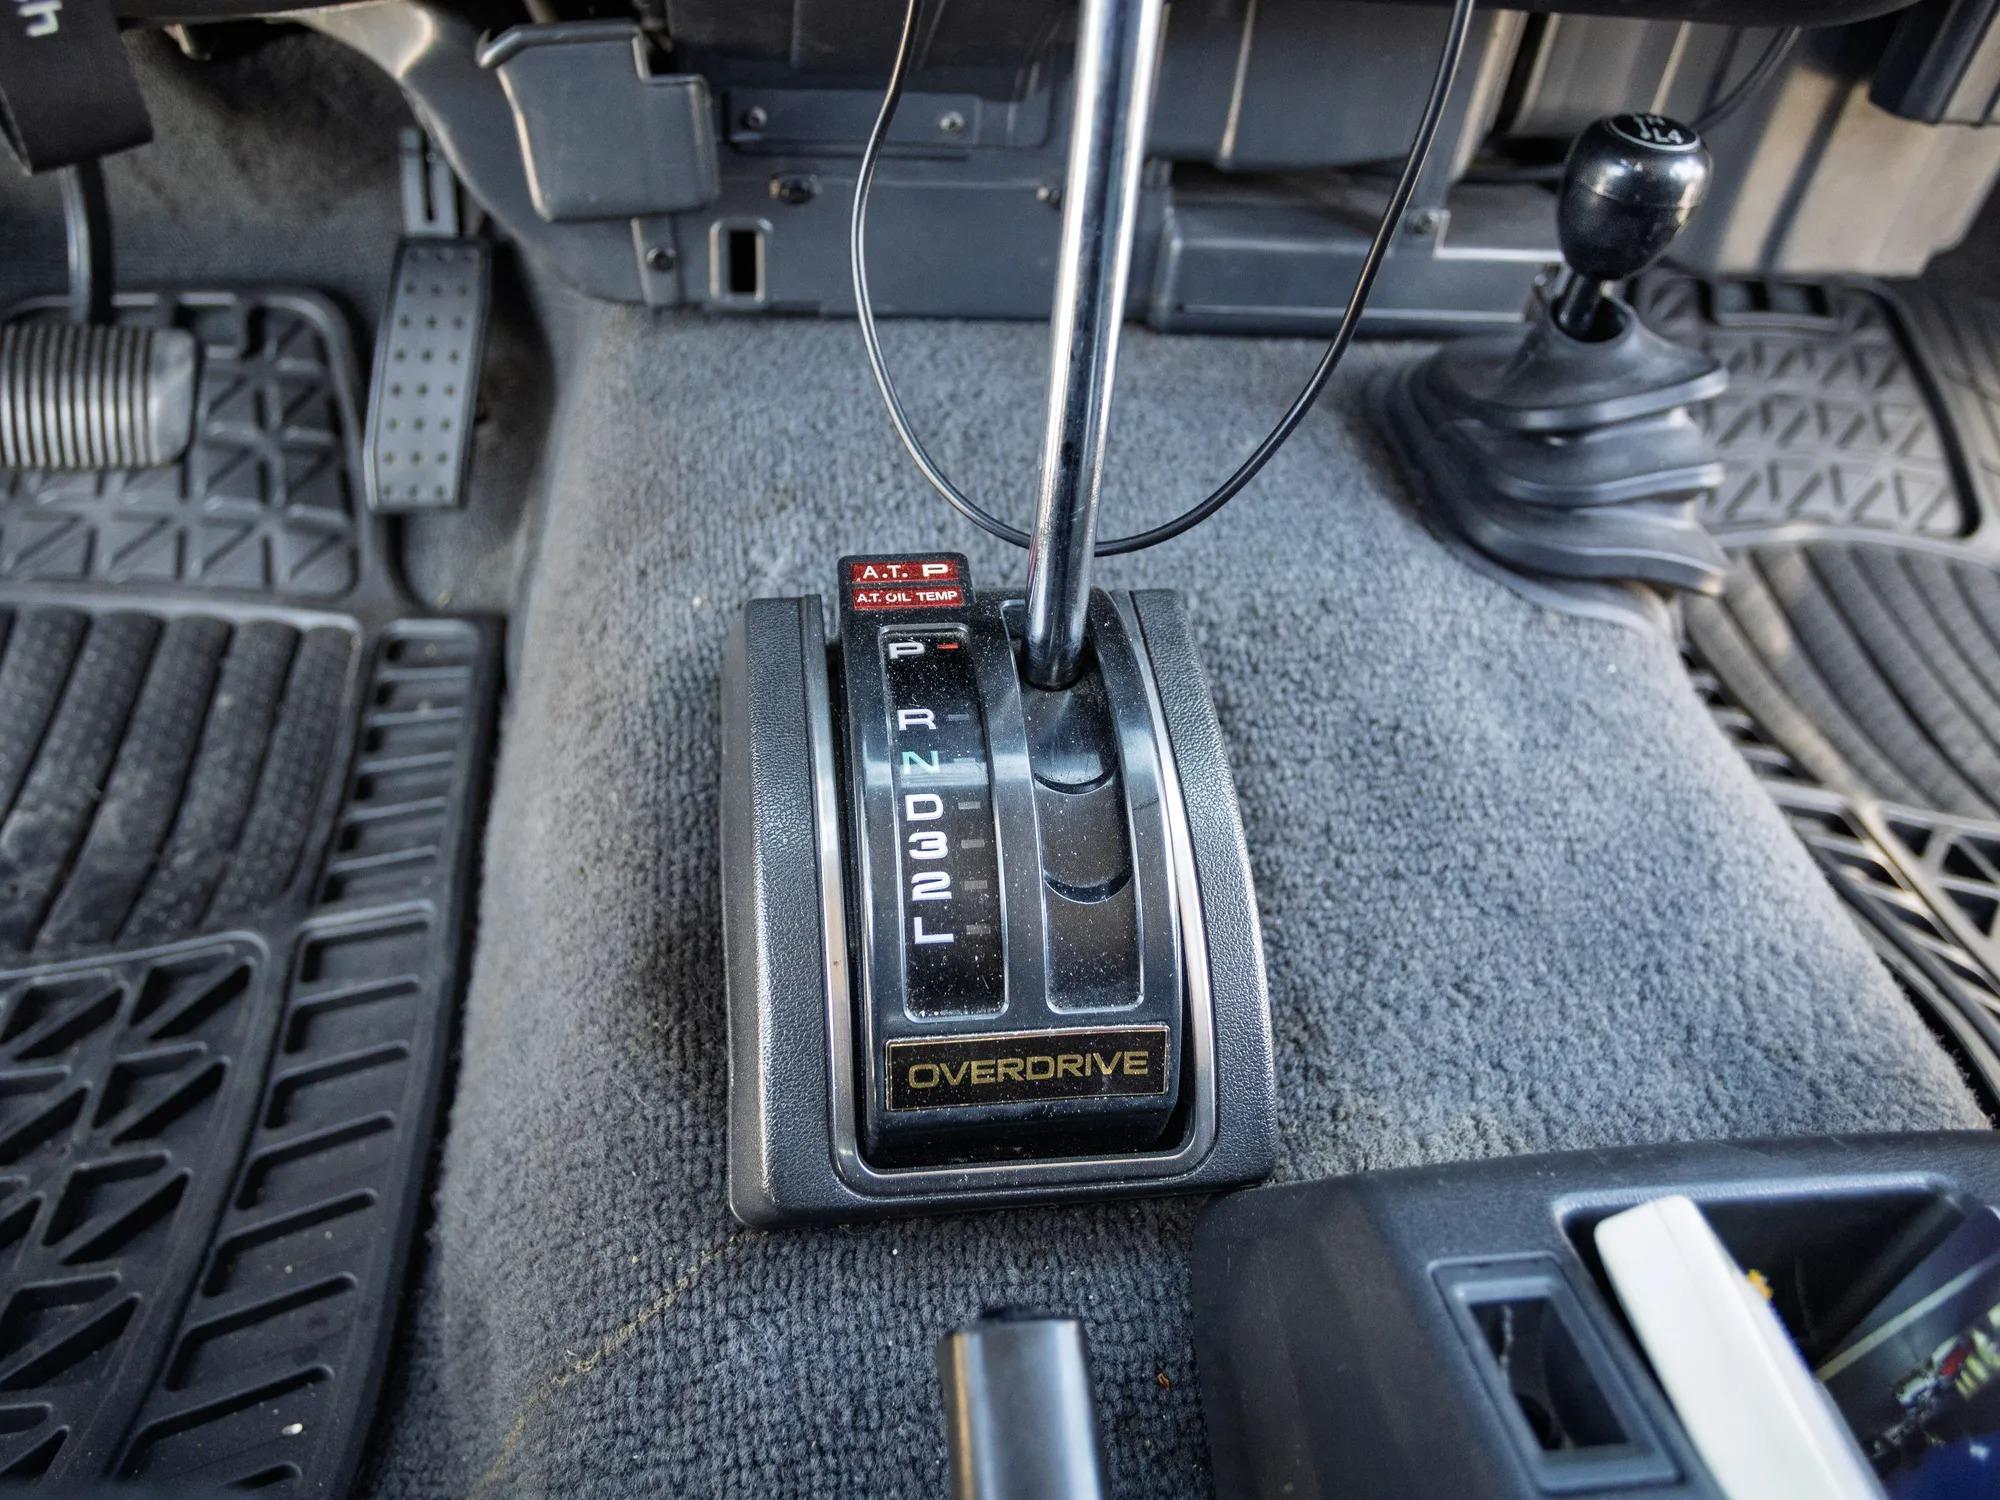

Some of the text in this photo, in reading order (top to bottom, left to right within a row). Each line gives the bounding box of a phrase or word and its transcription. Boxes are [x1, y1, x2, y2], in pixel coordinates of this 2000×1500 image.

[863, 563, 949, 579] A.T. P
[856, 590, 958, 603] A.T. OIL TEMP
[888, 641, 925, 660] P
[897, 708, 937, 730] R
[902, 750, 940, 775] N
[905, 793, 944, 821] D
[908, 830, 949, 860] 3
[911, 871, 952, 901] 2
[913, 916, 954, 944] L
[908, 1050, 1149, 1089] OVERDRIVE
